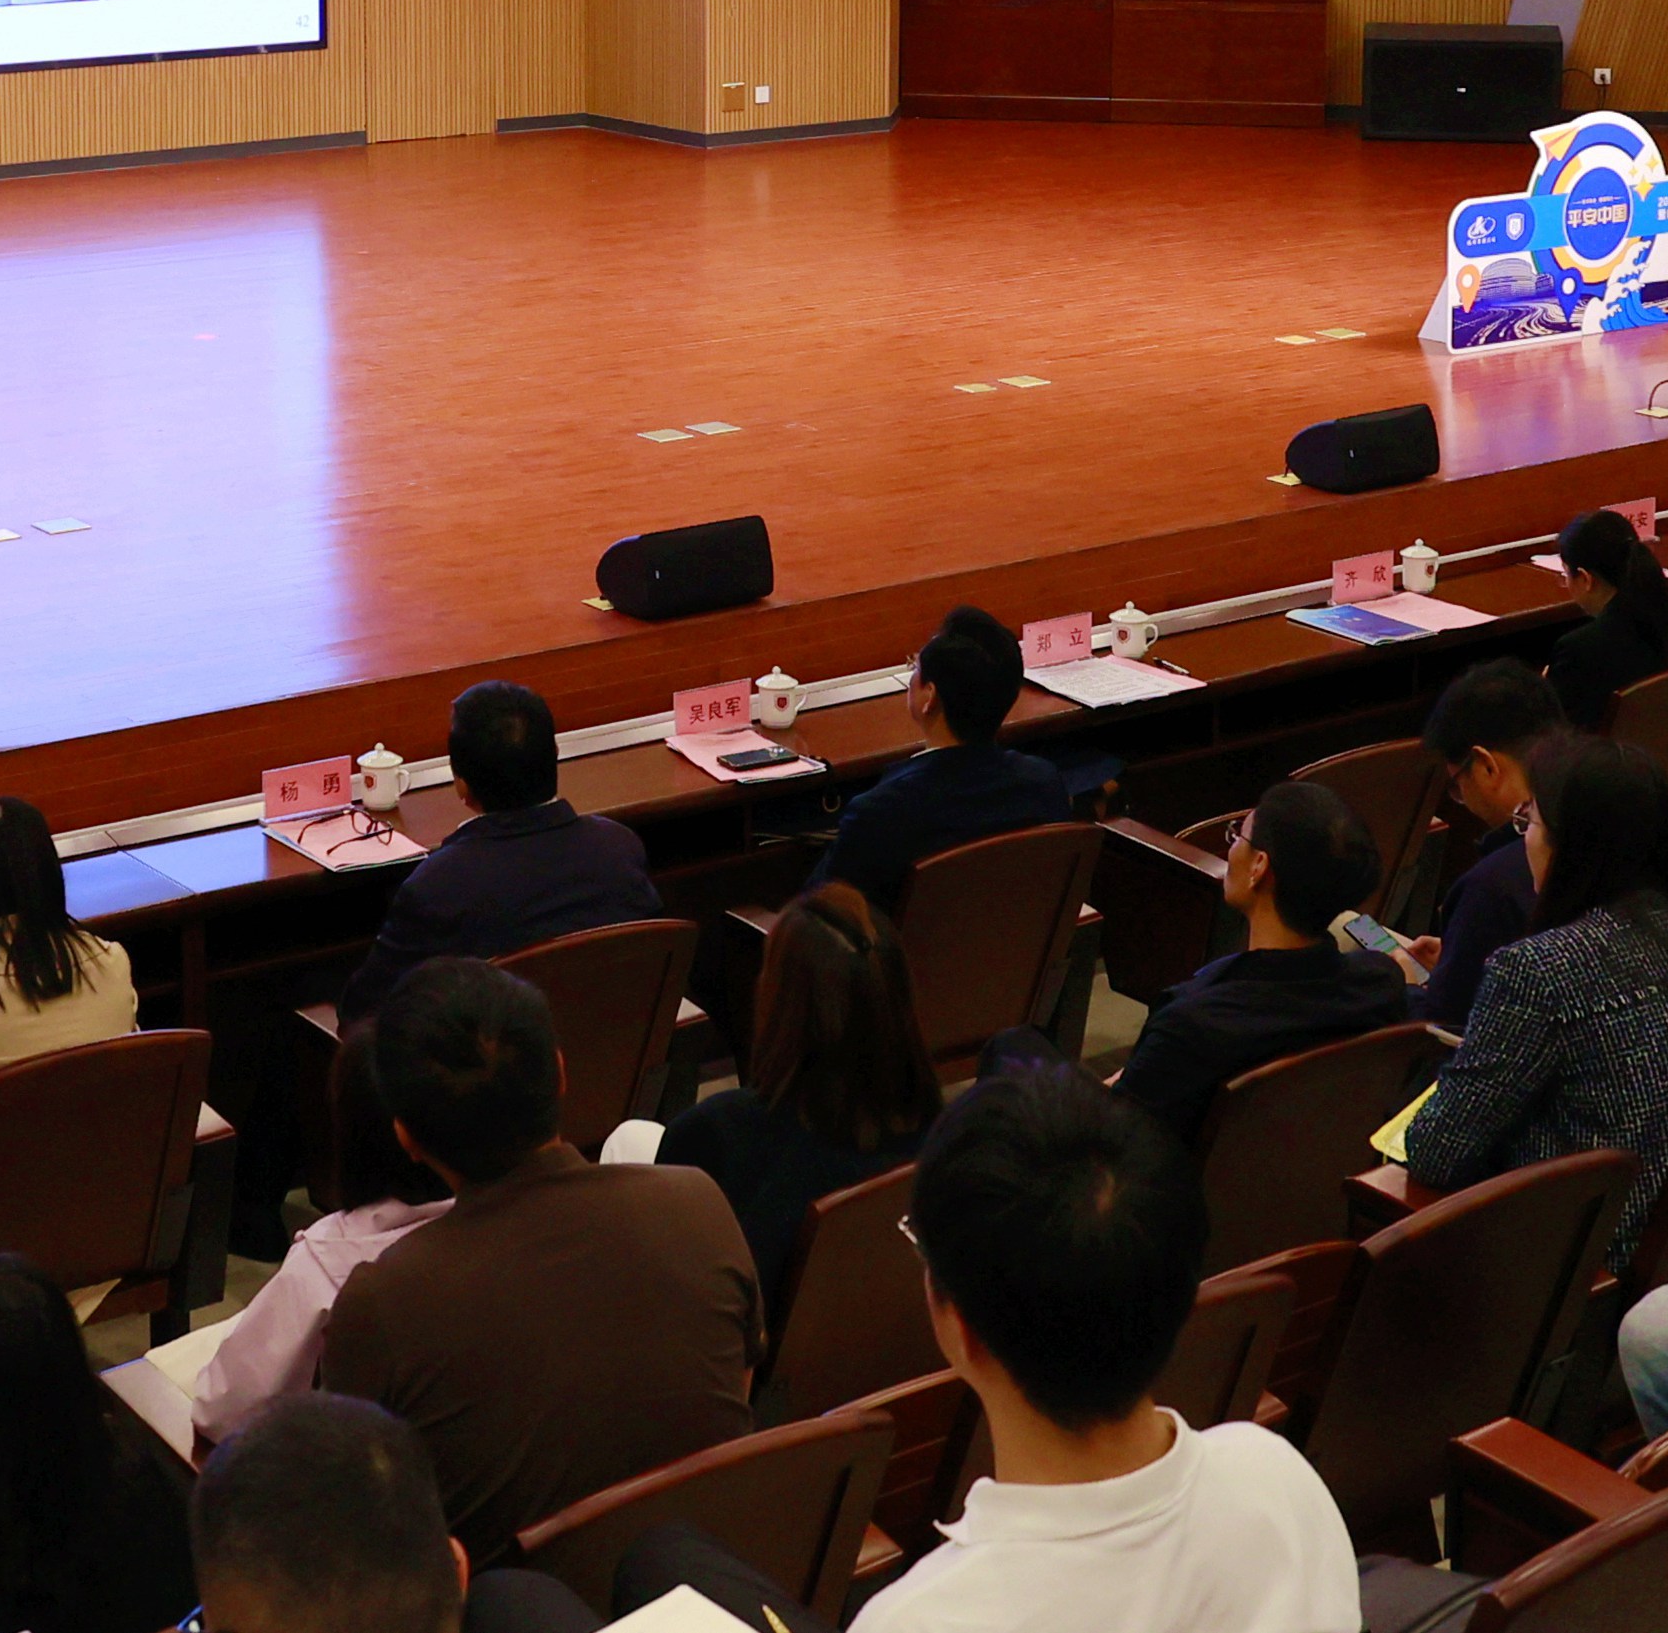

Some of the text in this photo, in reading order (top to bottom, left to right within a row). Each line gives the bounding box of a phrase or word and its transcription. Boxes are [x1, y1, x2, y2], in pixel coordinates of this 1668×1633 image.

[295, 15, 310, 29] 42
[1567, 203, 1628, 229] 平安中国
[689, 696, 741, 725] 吴良军
[280, 772, 340, 803] 杨勇
